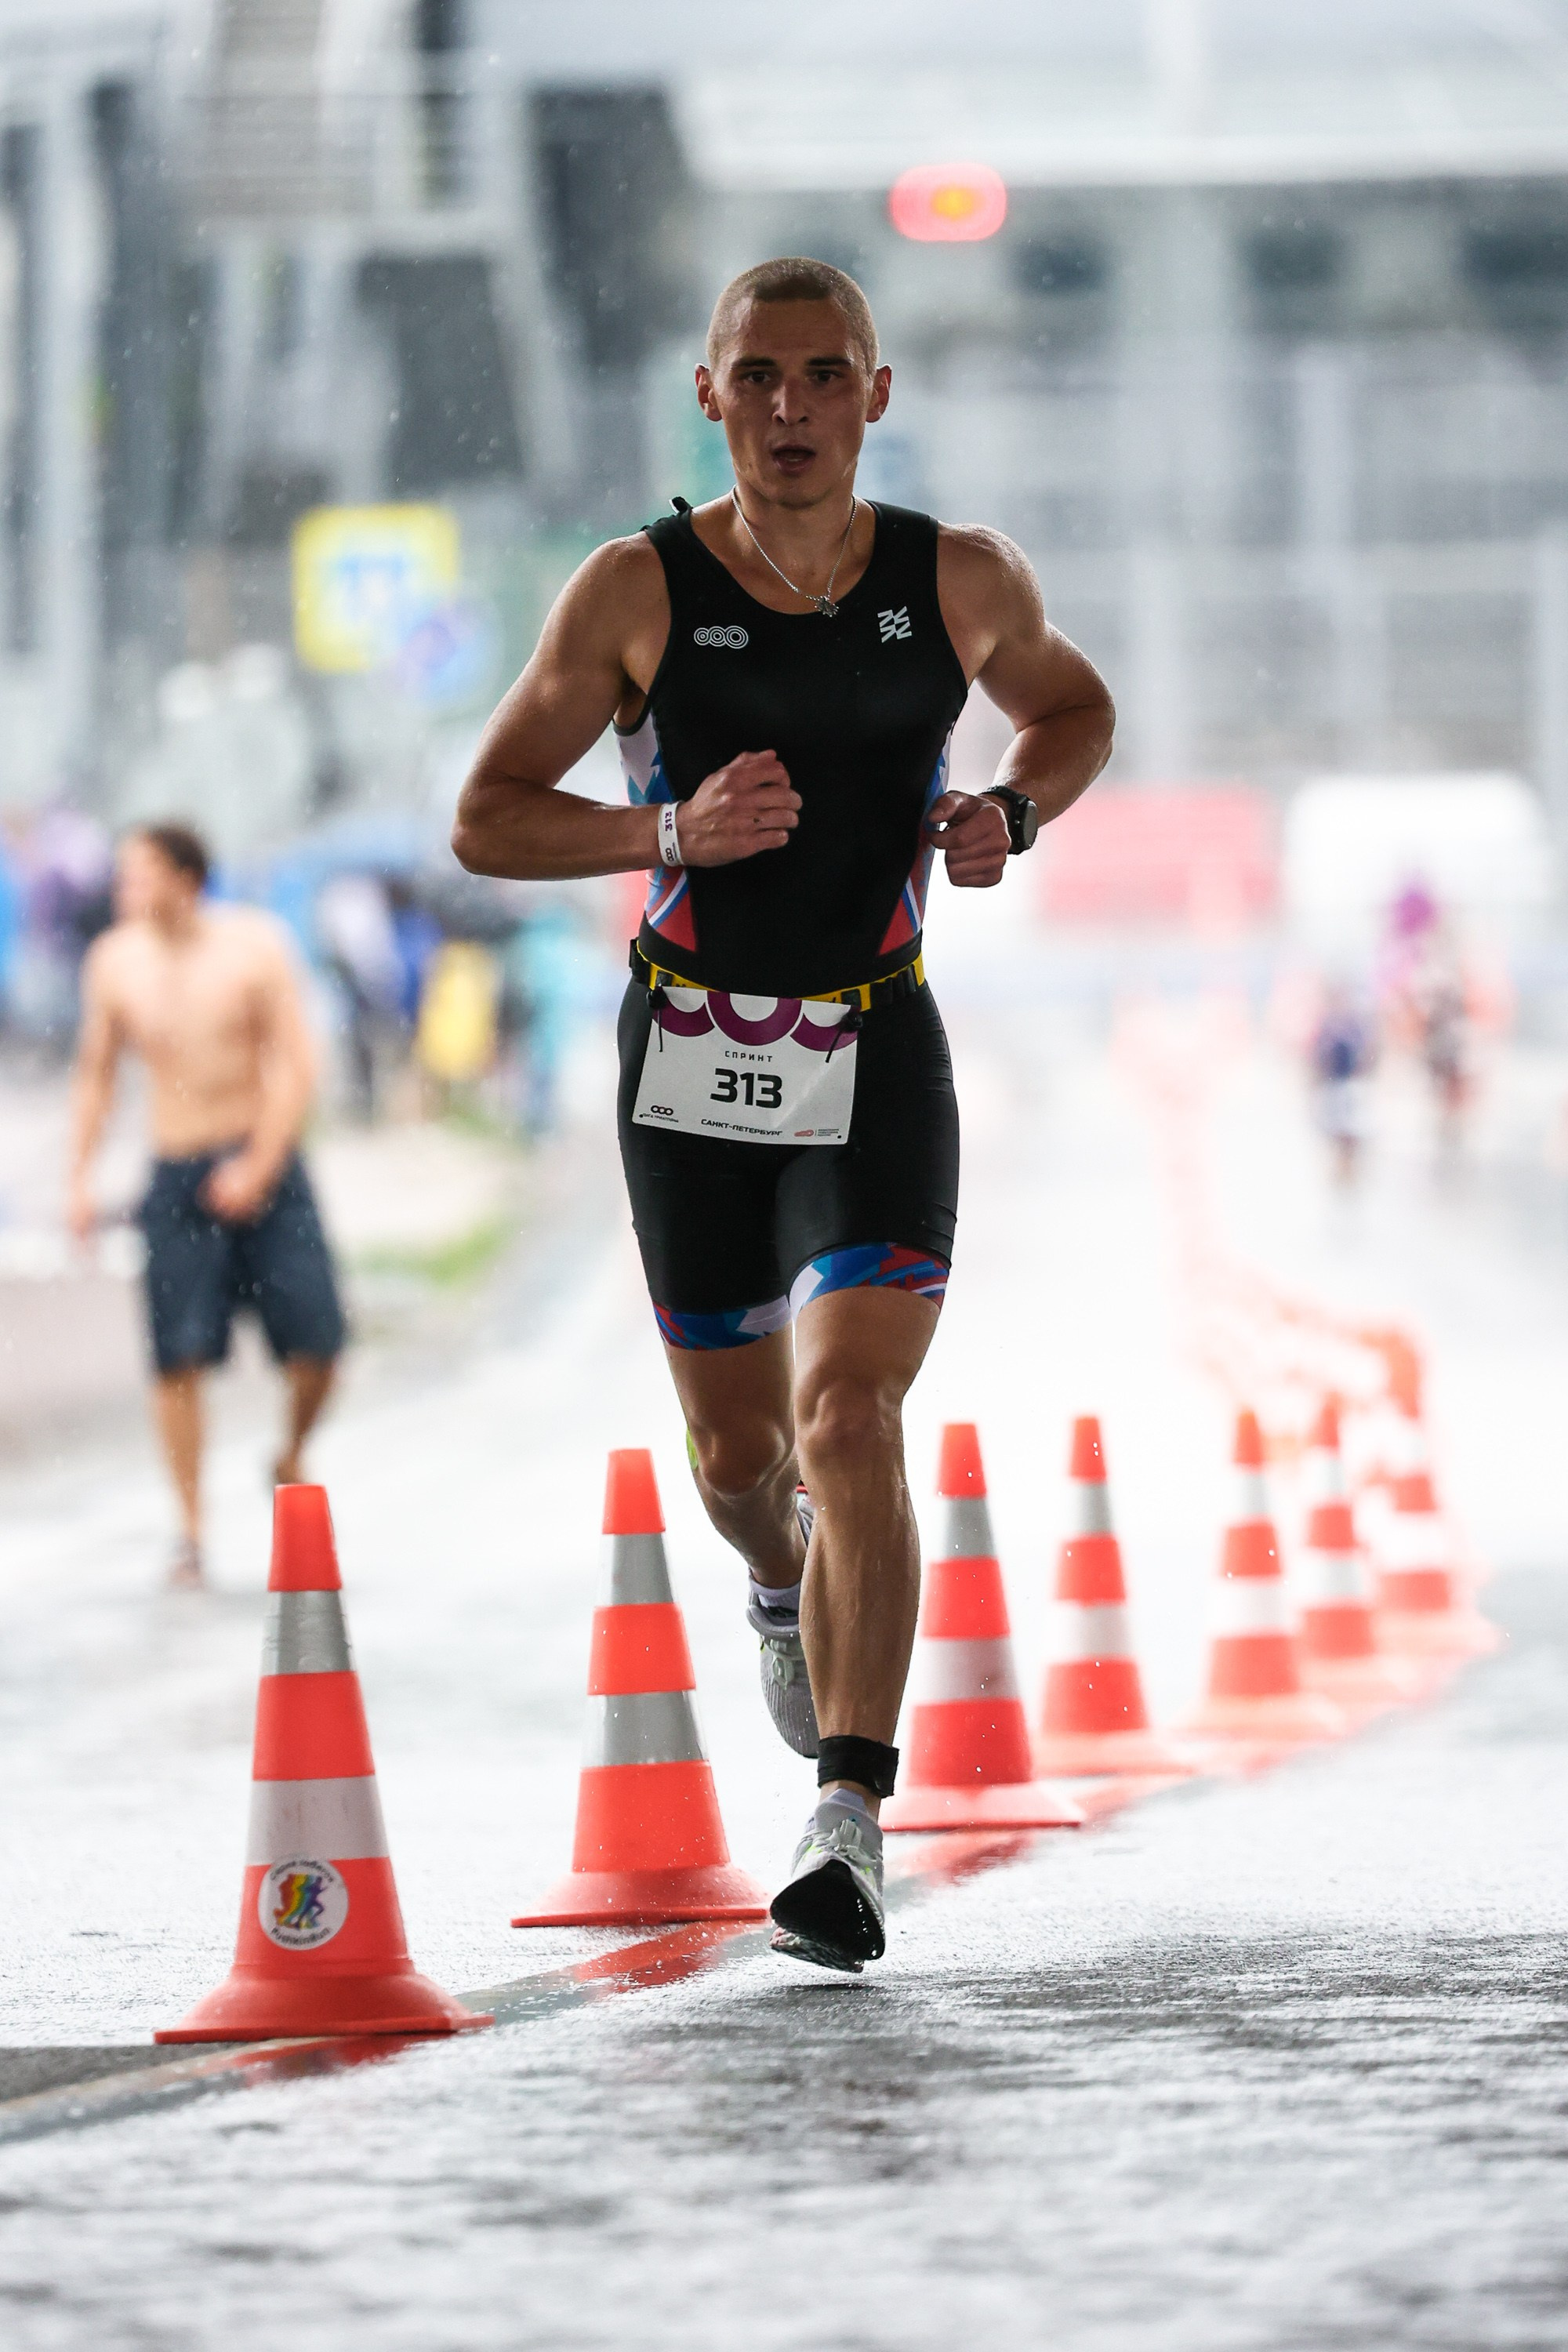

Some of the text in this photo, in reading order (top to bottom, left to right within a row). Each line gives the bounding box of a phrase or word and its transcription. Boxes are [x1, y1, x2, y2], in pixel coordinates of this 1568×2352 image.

[724, 1051, 773, 1063] СПРИНТ
[710, 1068, 782, 1109] 313
[701, 1119, 782, 1136] САНКТ-ПЕТЕРБУРГ
